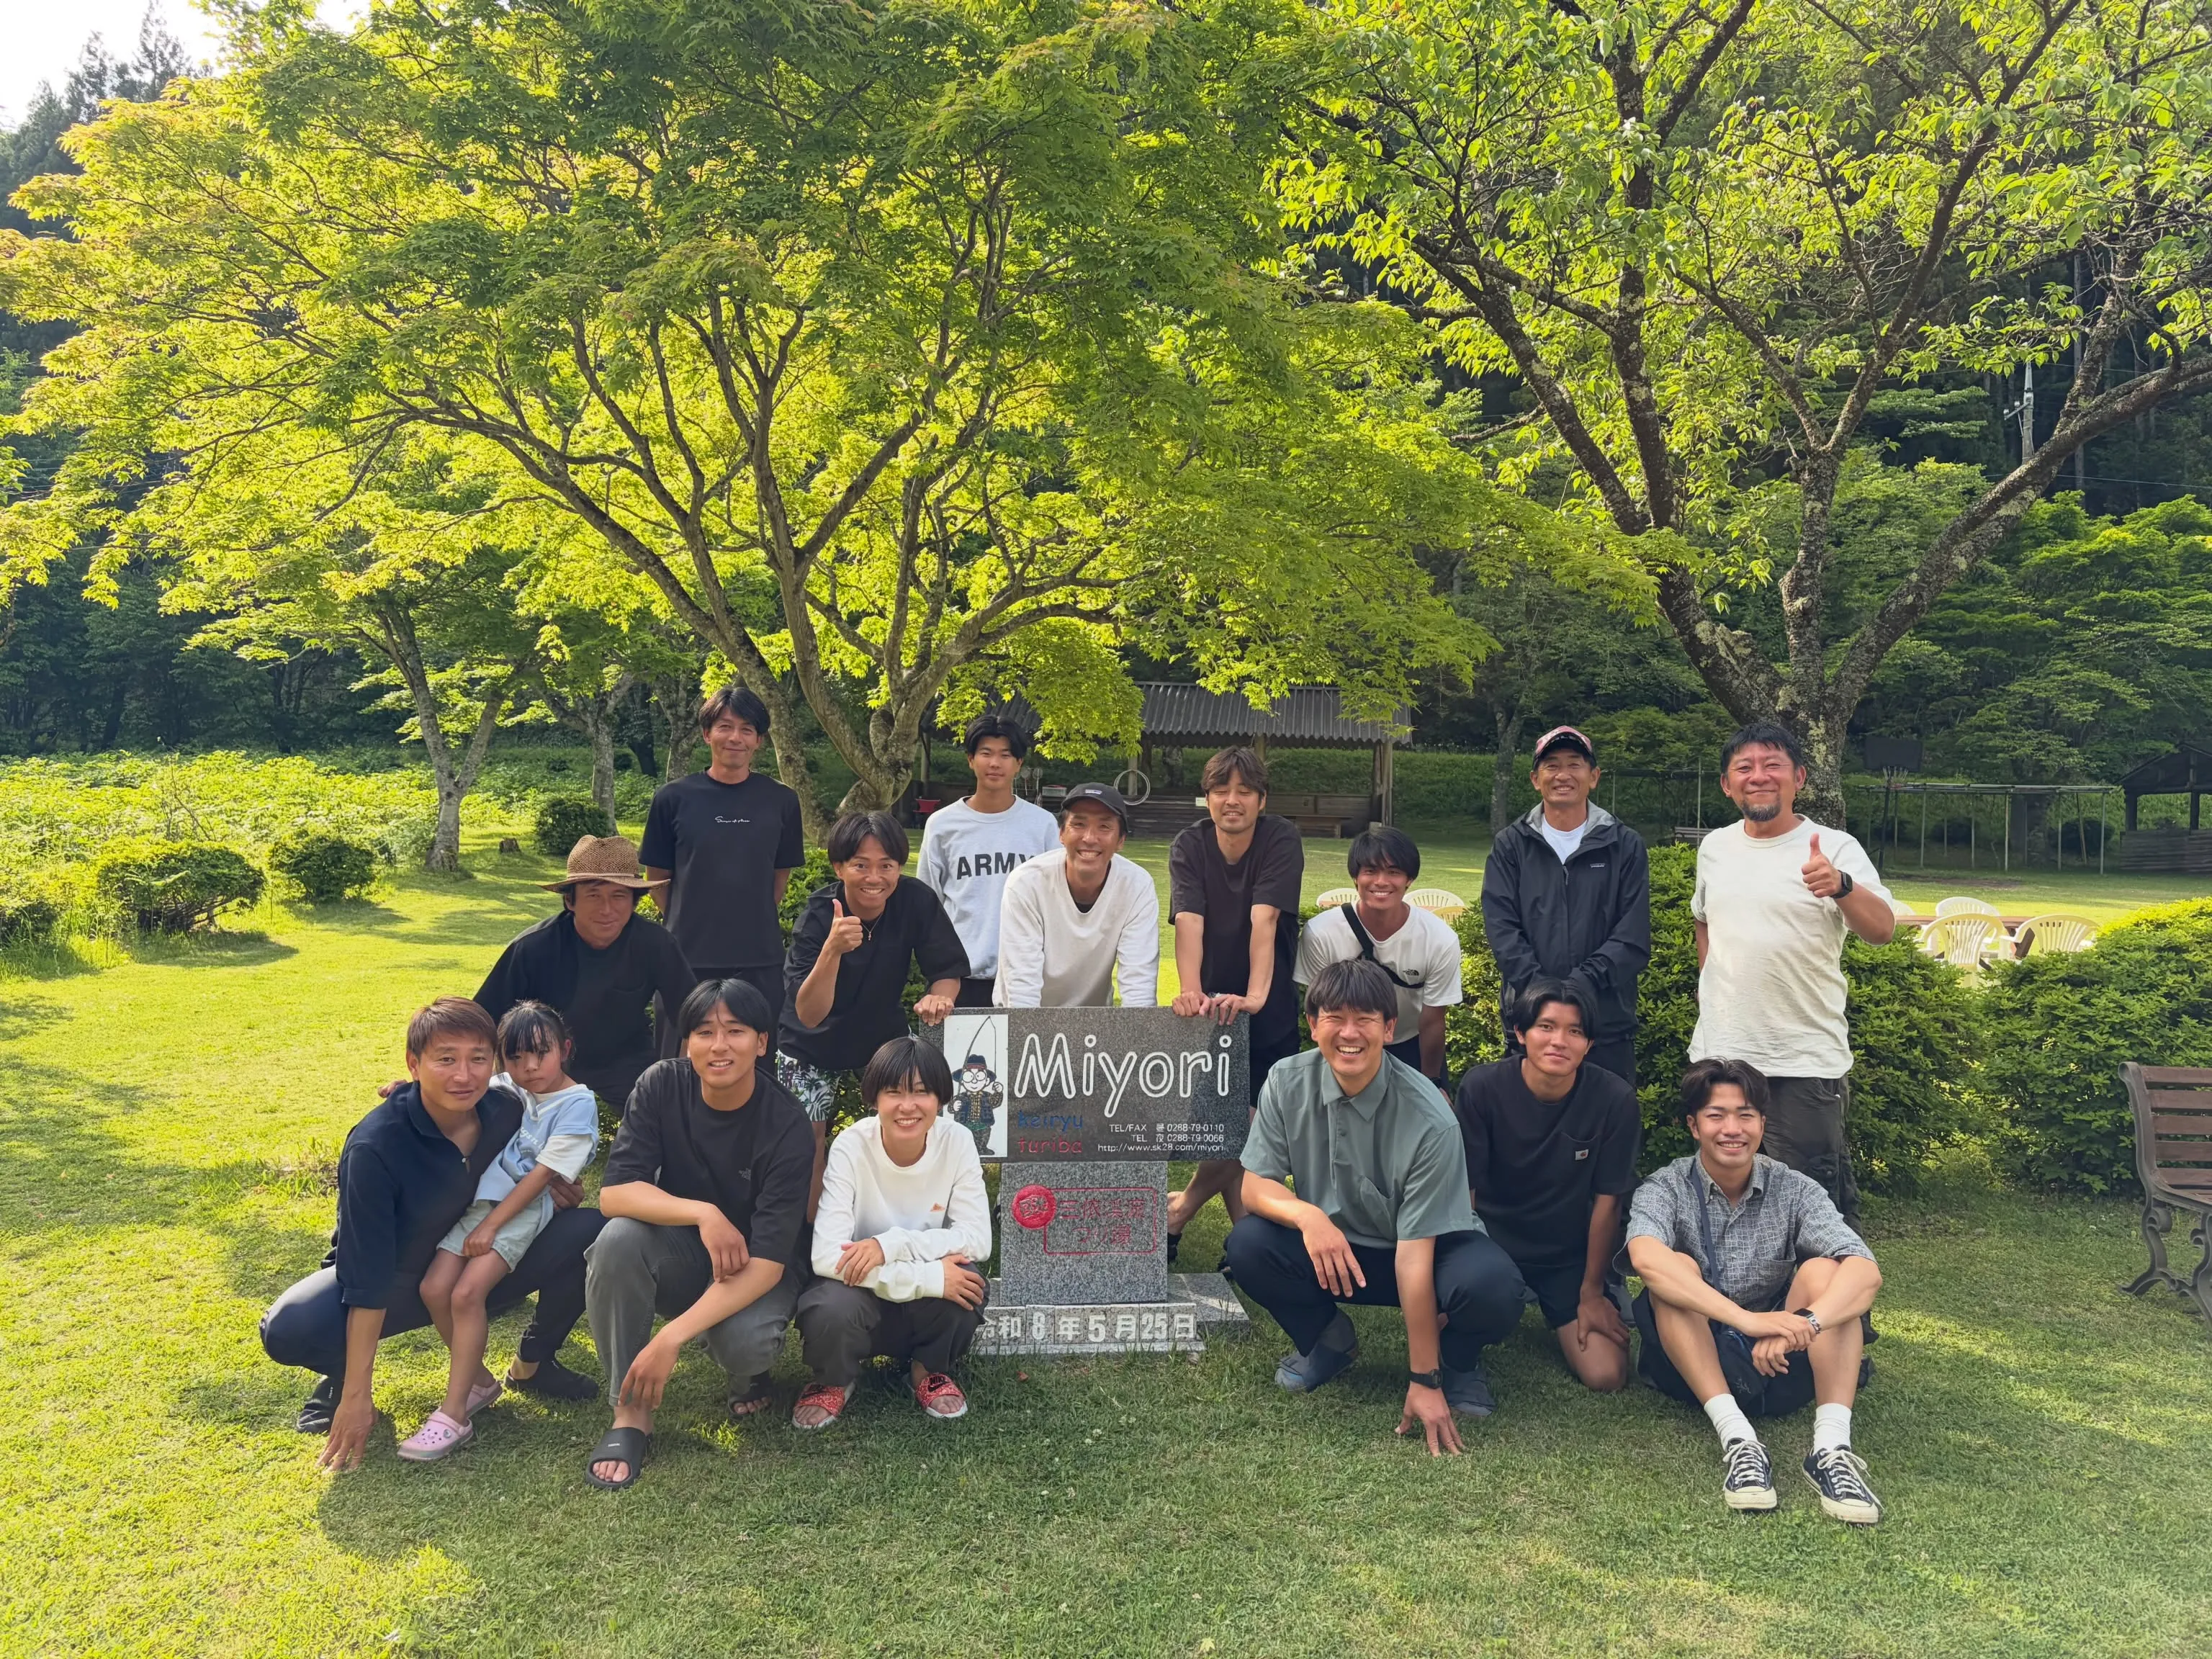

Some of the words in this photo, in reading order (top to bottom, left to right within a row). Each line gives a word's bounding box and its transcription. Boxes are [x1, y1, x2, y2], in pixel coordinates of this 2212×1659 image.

[1014, 1033, 1232, 1118] Miyori
[1017, 1110, 1083, 1133] keiryu
[1166, 1123, 1224, 1132] 0288-79-0110
[1017, 1136, 1083, 1154] turiba
[1131, 1134, 1148, 1143] TEL
[1156, 1133, 1164, 1143] 夜
[1166, 1134, 1224, 1143] 0288-79-0066
[1097, 1143, 1224, 1152] http://www.sk28.com/miyori
